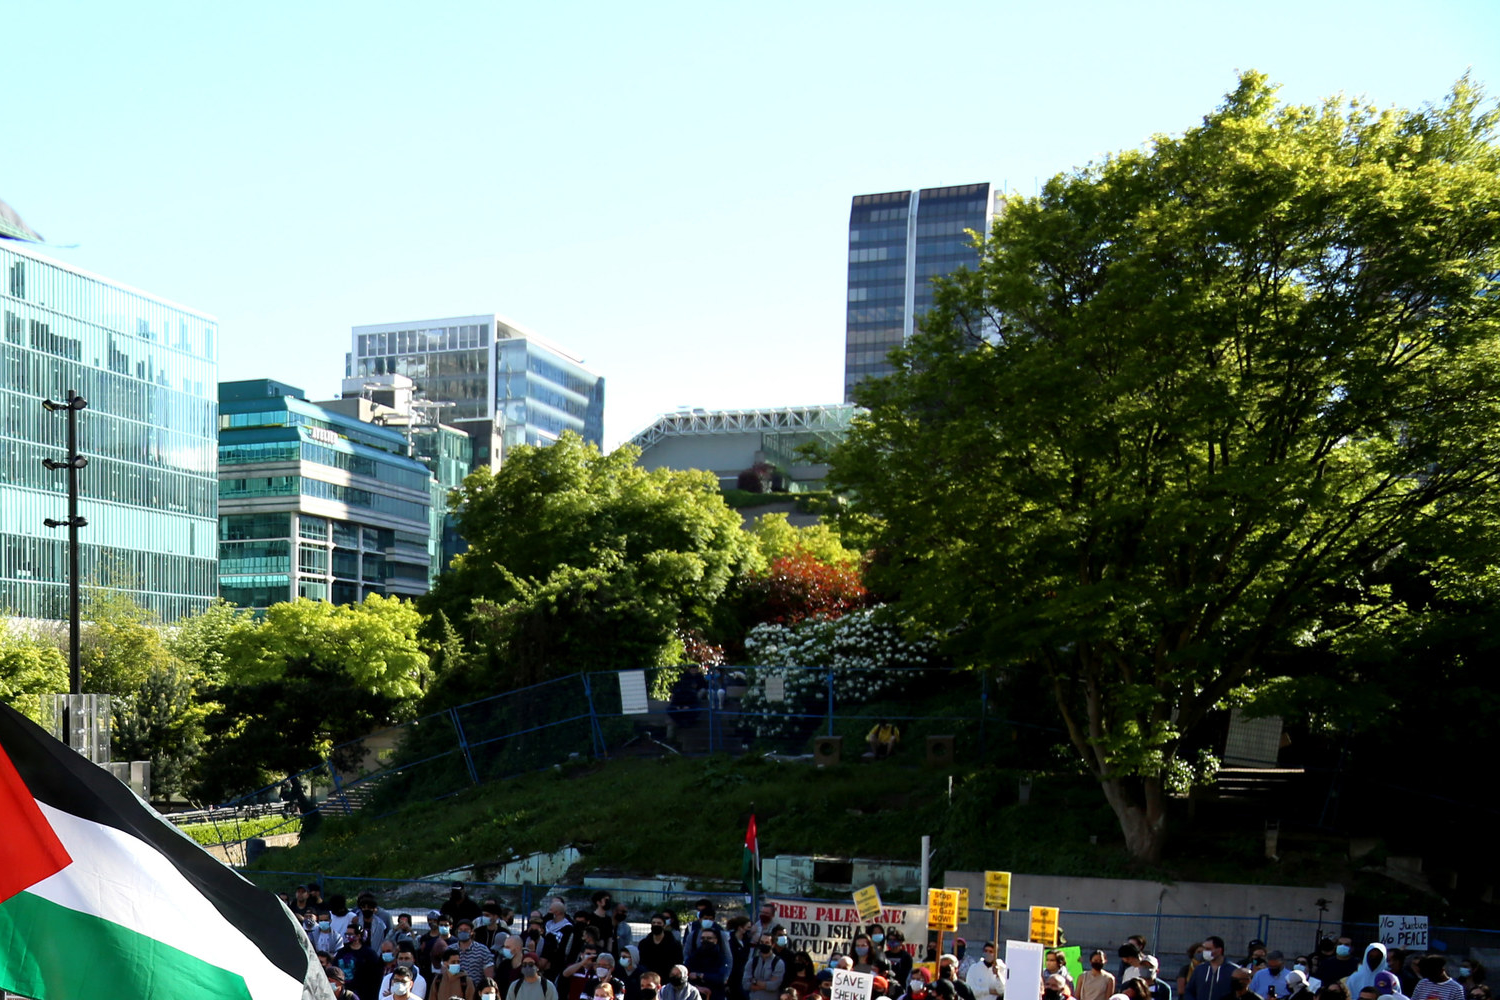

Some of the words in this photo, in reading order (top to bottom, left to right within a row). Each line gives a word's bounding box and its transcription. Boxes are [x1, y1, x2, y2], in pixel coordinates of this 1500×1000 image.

[934, 891, 952, 900] Stop
[933, 900, 953, 908] Siege
[939, 908, 955, 916] Gaza
[932, 914, 952, 922] NOW!
[1380, 916, 1394, 928] No
[790, 921, 821, 937] END
[1381, 932, 1394, 945] No
[1397, 931, 1427, 946] PEACE
[835, 972, 864, 989] SAVE
